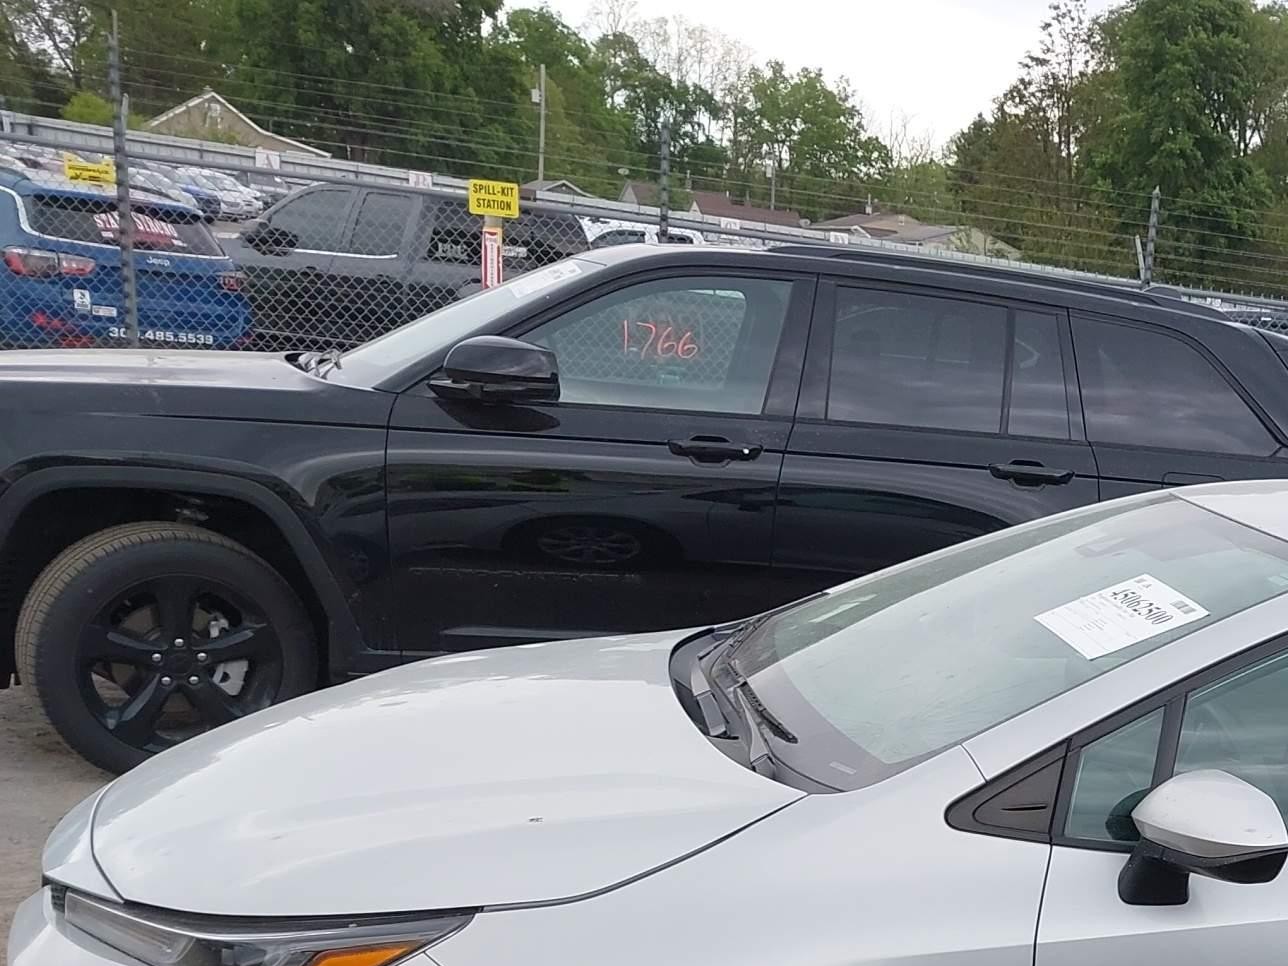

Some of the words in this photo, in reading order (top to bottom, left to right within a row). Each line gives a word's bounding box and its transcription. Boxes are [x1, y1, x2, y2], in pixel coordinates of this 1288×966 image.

[472, 183, 515, 198] SPILL-KIT
[475, 198, 512, 211] STATION
[146, 255, 170, 266] Jeep
[108, 327, 214, 345] 30.485.5539
[623, 319, 699, 360] 1766
[1109, 588, 1174, 625] 45062500
